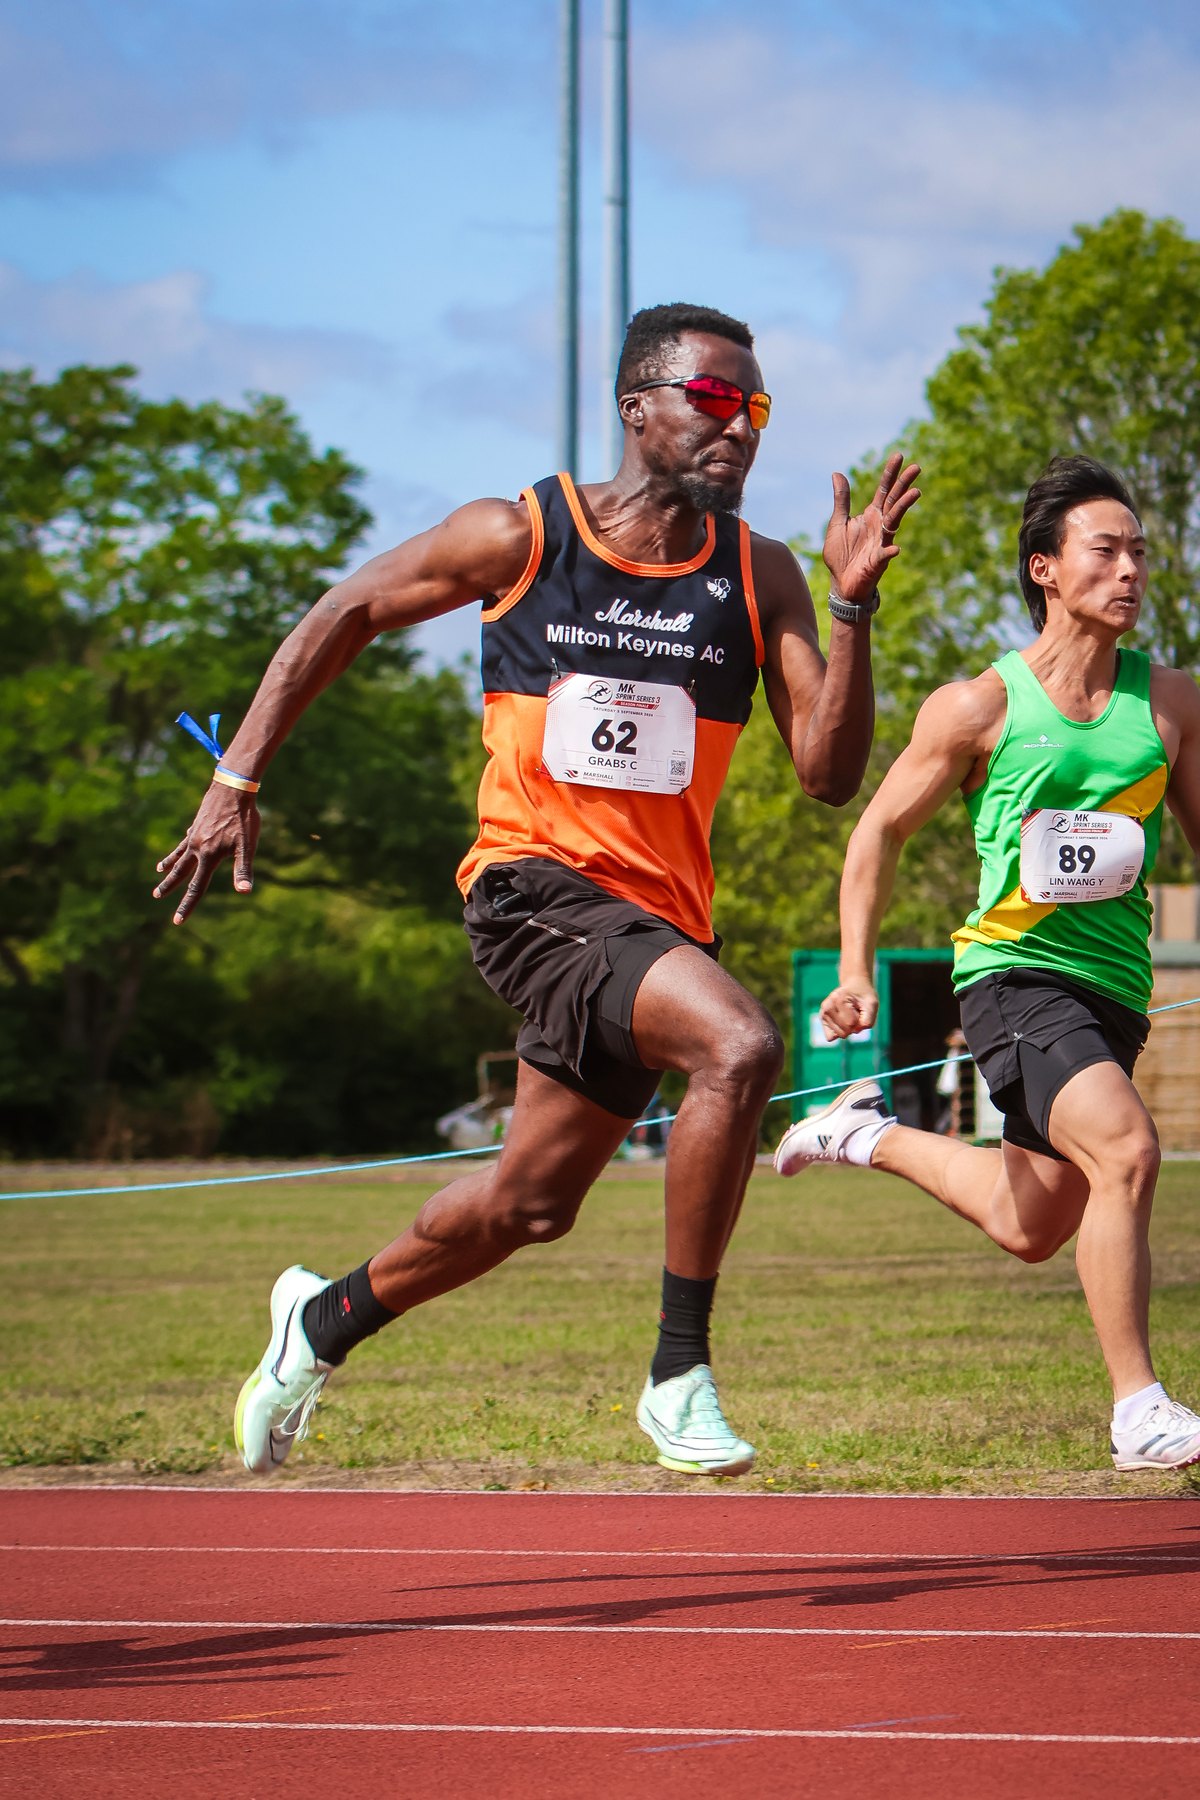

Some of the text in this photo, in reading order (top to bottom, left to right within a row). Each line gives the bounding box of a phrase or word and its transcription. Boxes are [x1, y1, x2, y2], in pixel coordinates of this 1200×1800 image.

[595, 598, 694, 632] Marshall
[546, 624, 724, 664] Milton Keynes AC
[618, 683, 636, 693] MK
[615, 693, 636, 701] SPRINT
[636, 695, 655, 703] SERIES
[592, 719, 638, 755] 62
[588, 756, 638, 770] GRABS C
[583, 771, 614, 780] MARSHALL
[1074, 813, 1090, 822] MK
[1059, 844, 1096, 874] 89
[1049, 877, 1105, 886] LIN WANG Y
